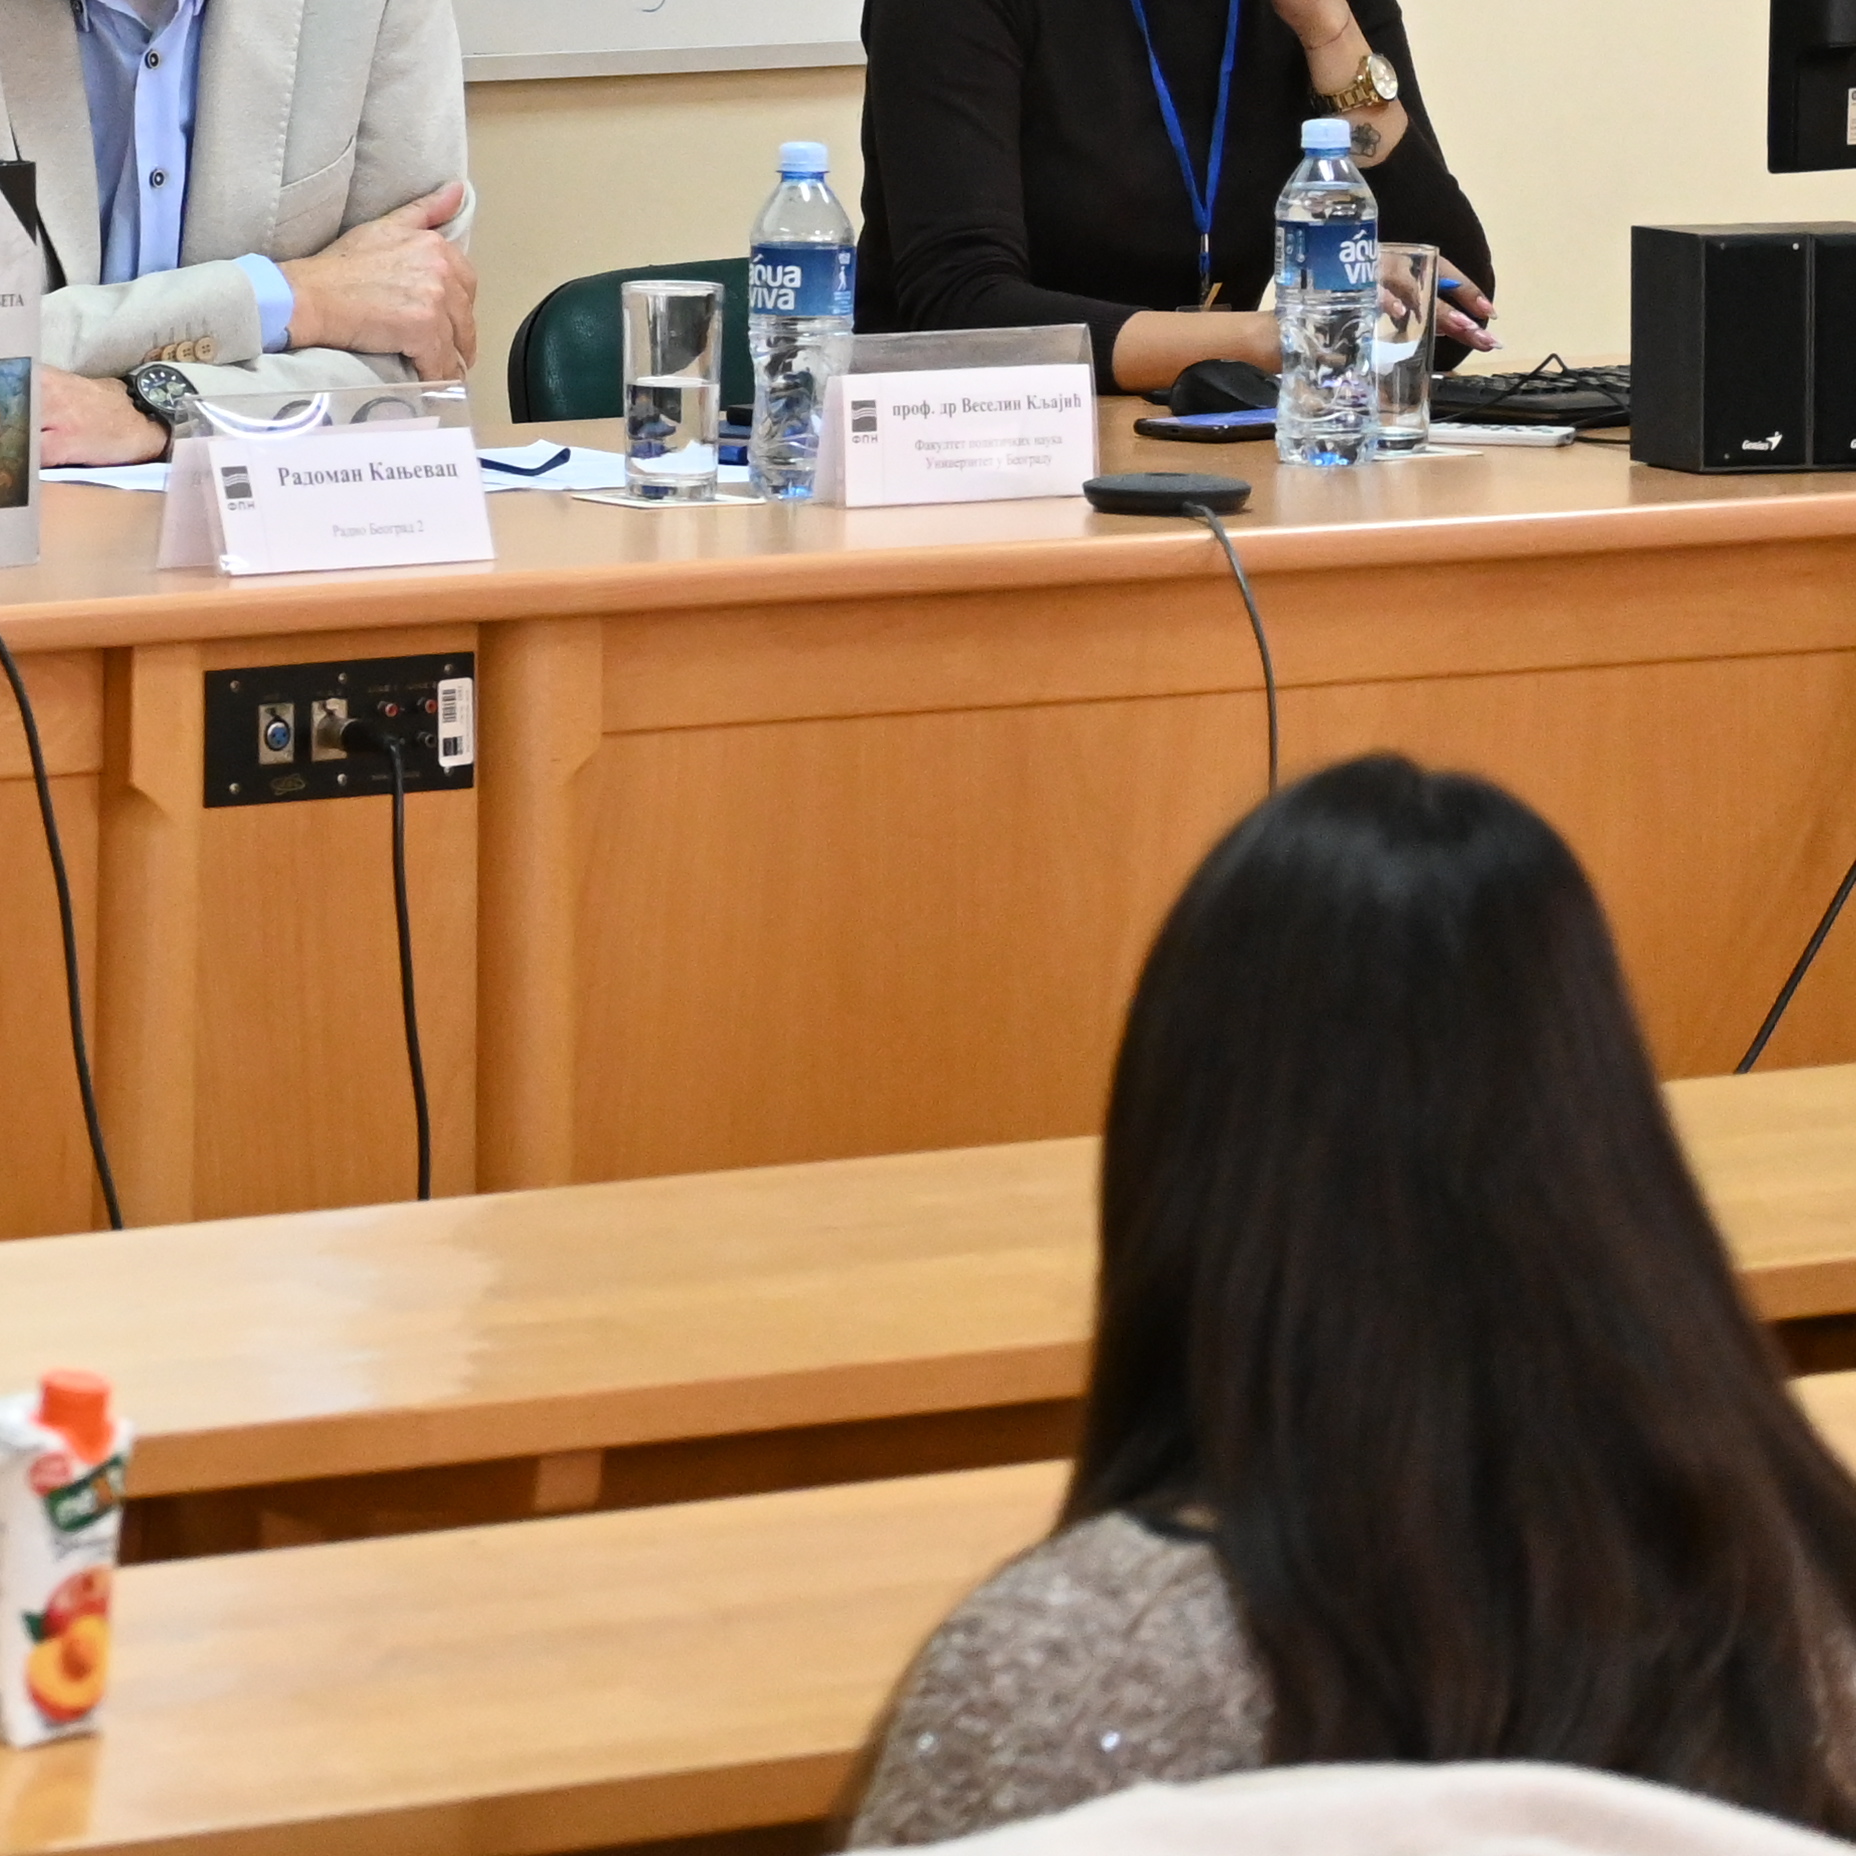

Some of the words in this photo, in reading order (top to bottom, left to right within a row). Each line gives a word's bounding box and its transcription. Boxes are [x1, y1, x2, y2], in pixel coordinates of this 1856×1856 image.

[892, 399, 935, 421] проф.
[940, 403, 957, 420] др
[962, 396, 1022, 415] Веселин
[1026, 392, 1082, 413] Кљајић
[851, 434, 879, 445] ФПН
[278, 465, 364, 488] Радоман
[368, 460, 459, 482] Кањевац
[226, 500, 255, 512] ФПН
[416, 519, 425, 533] 2
